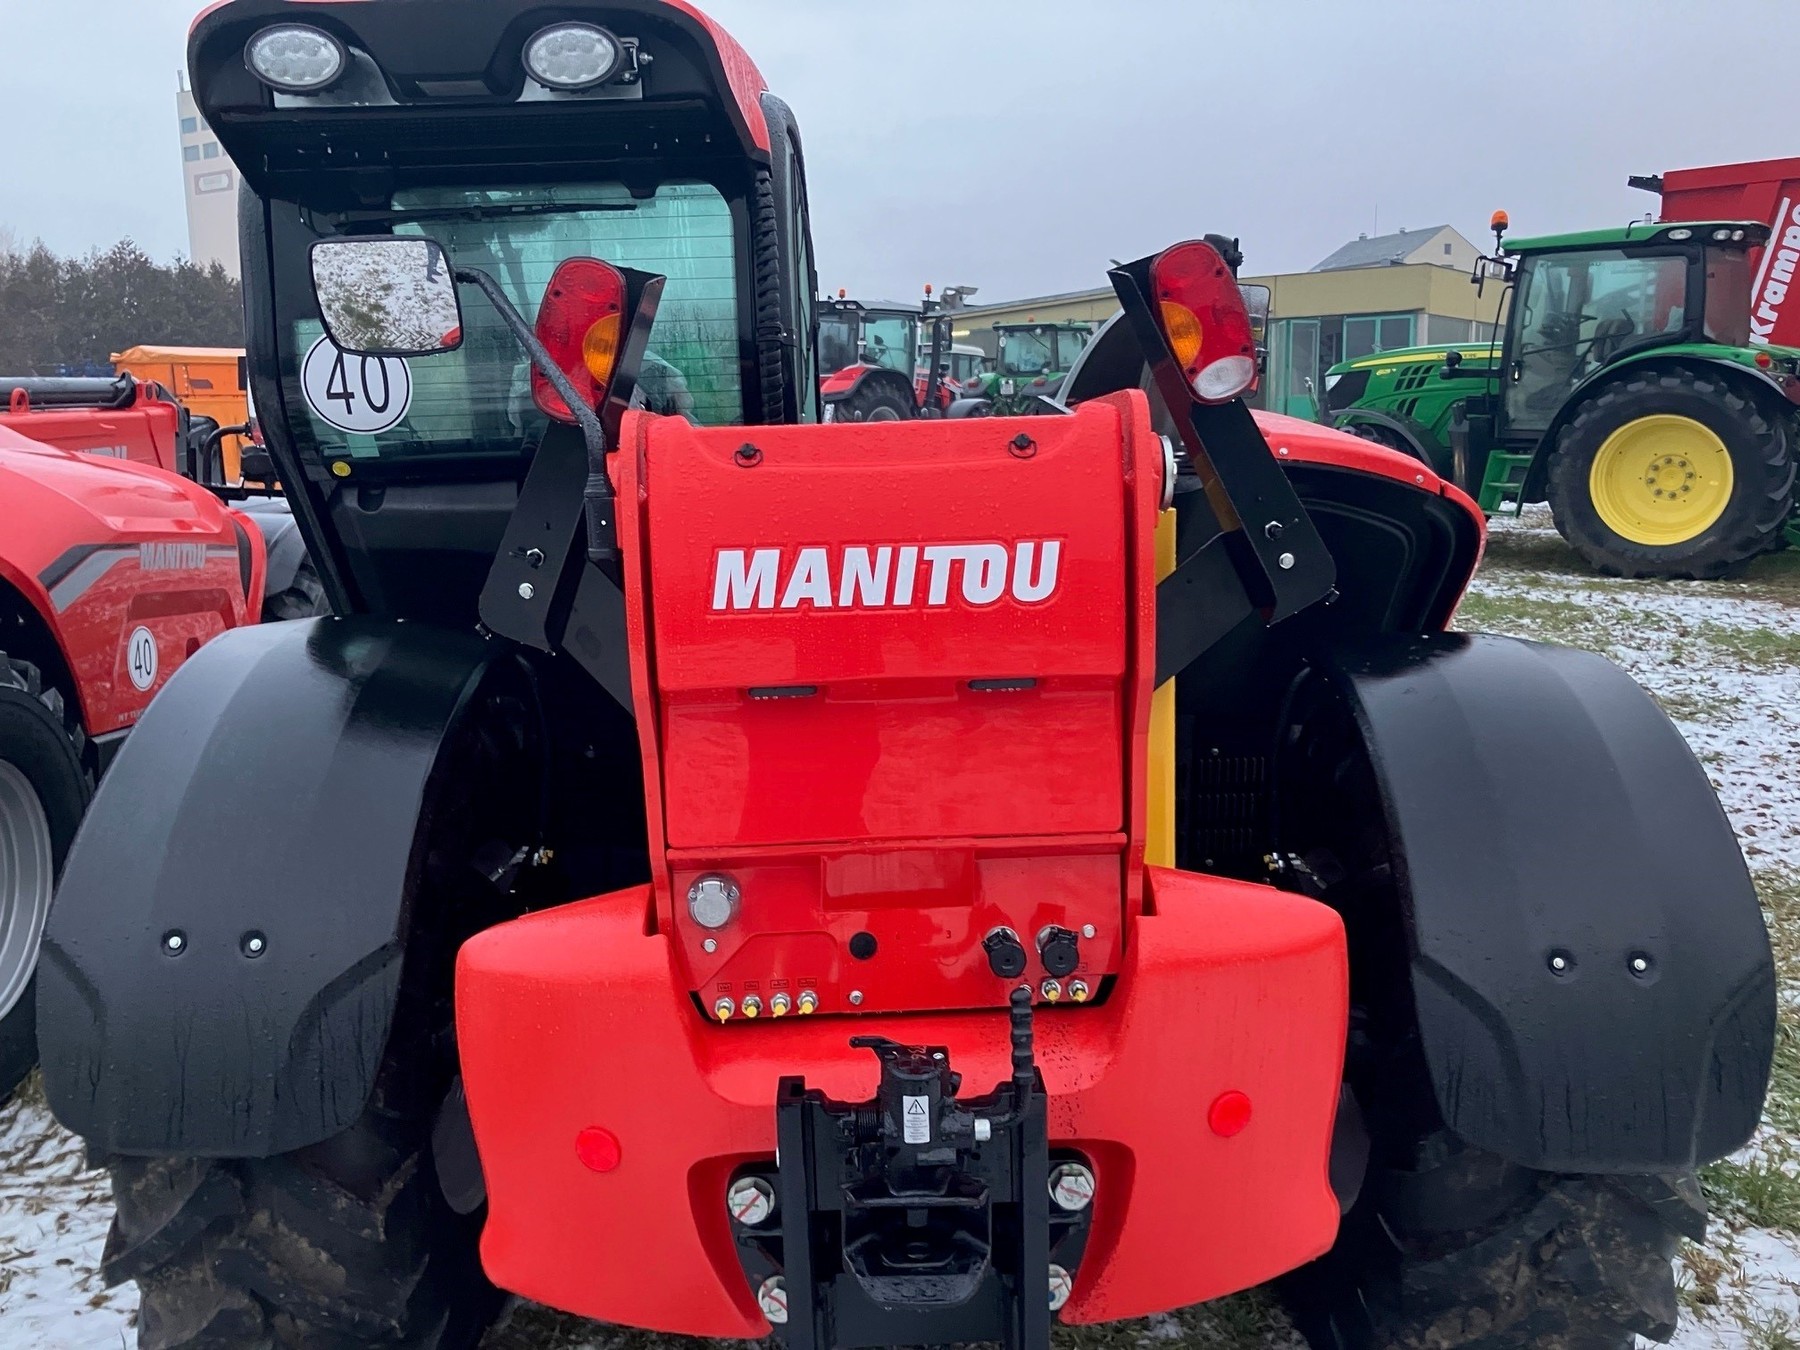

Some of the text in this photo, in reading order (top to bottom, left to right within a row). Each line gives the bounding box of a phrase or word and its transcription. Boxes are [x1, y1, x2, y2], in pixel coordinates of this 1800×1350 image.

[326, 352, 390, 415] 40
[140, 543, 207, 570] MANITOU
[712, 541, 1061, 610] MANITOU
[135, 638, 152, 678] 40
